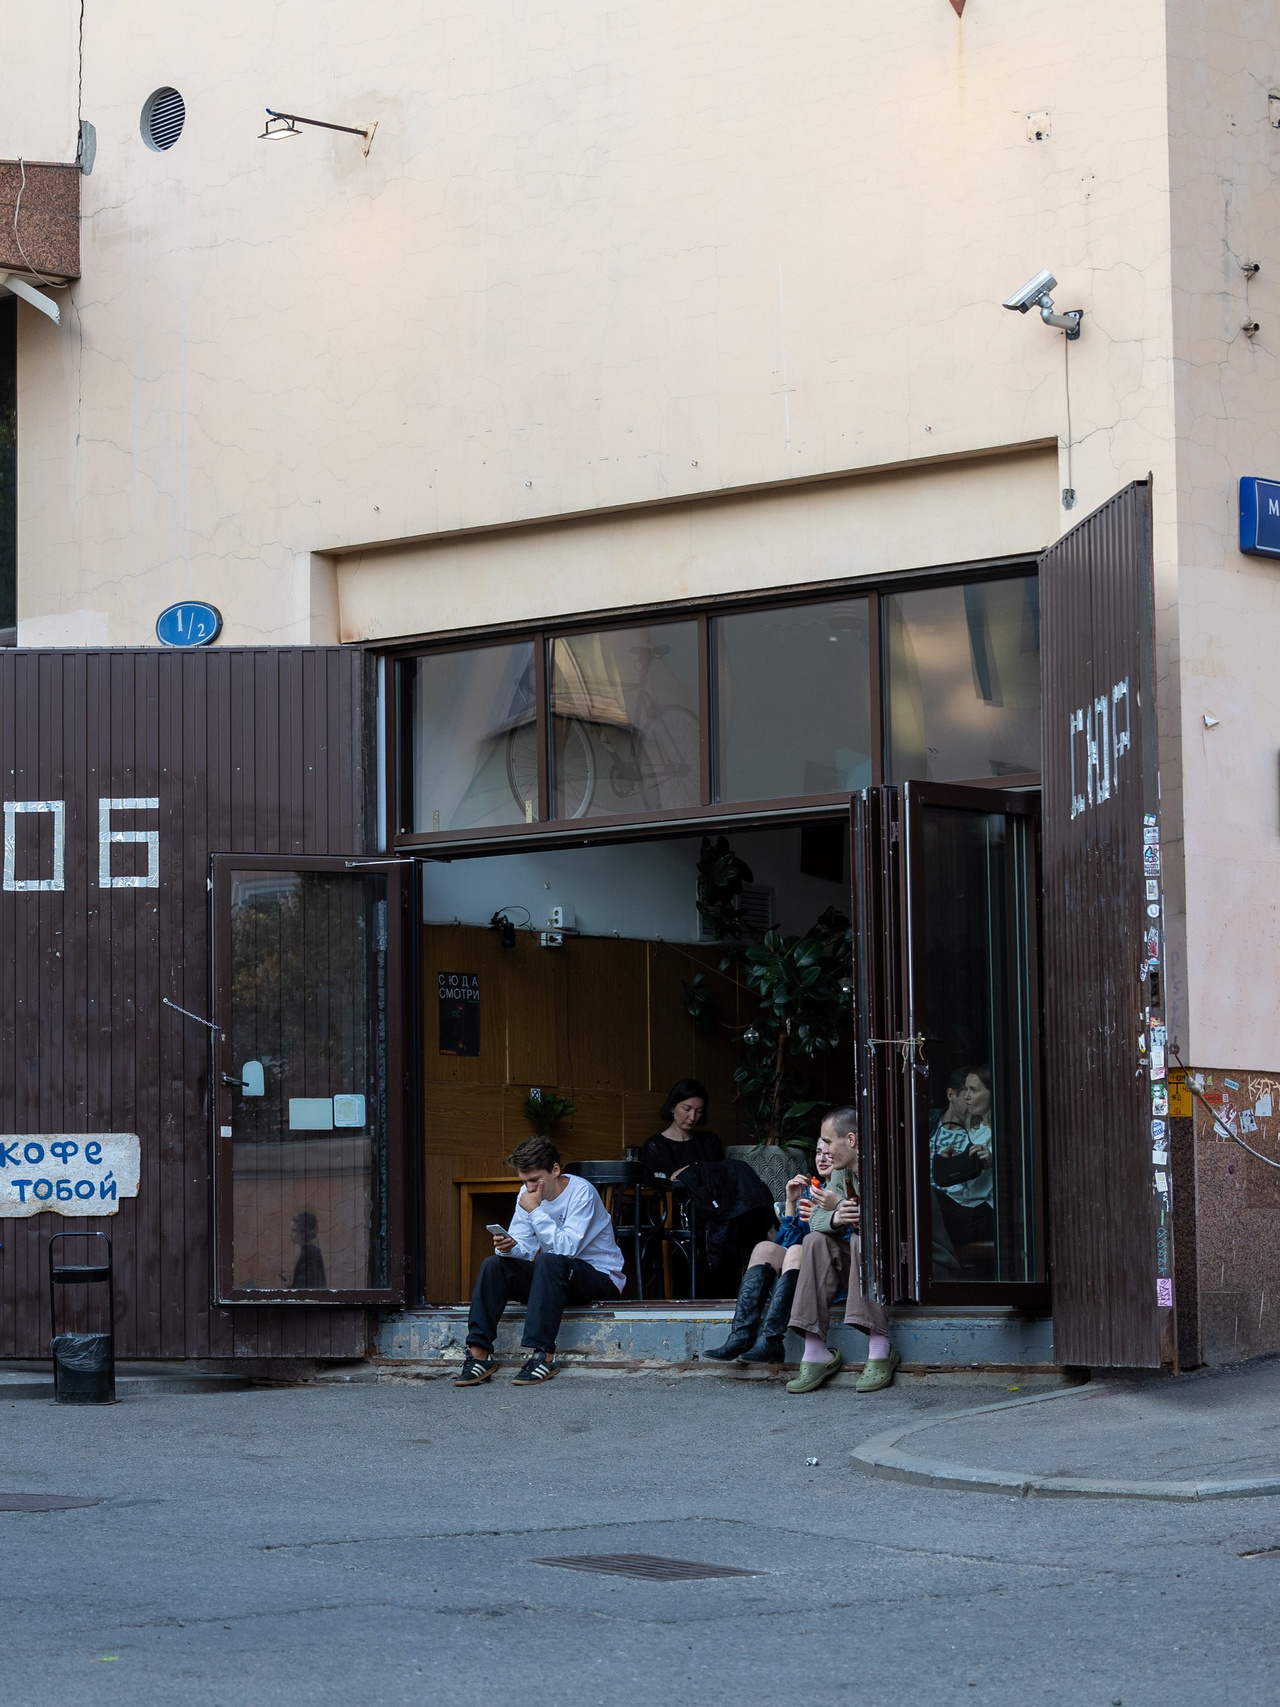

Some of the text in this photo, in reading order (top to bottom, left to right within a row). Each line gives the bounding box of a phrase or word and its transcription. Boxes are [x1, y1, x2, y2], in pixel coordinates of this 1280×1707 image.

[176, 609, 206, 640] 1/2
[438, 974, 478, 988] СЮДА
[439, 988, 480, 1000] СМОТРИ
